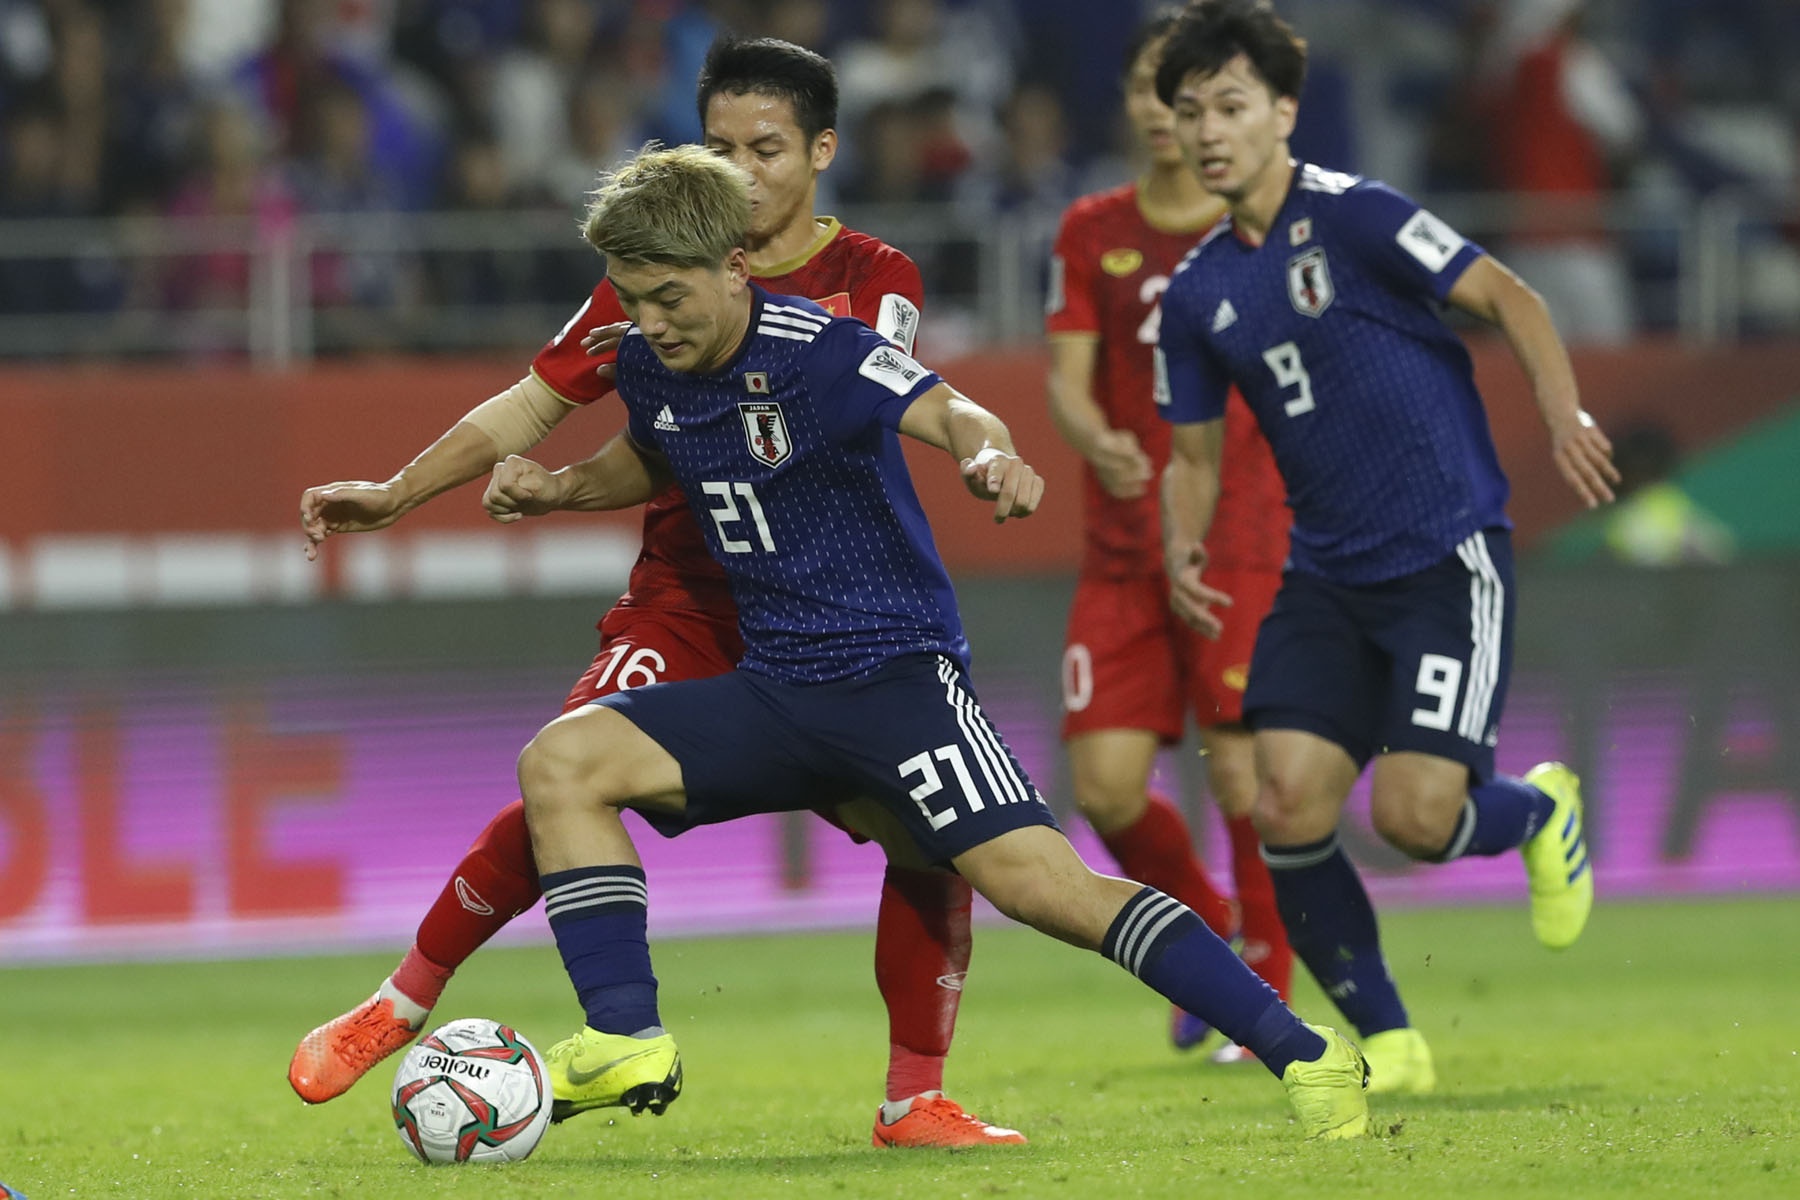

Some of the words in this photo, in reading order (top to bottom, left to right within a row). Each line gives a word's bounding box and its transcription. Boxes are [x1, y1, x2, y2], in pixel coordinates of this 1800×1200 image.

[1262, 341, 1315, 417] 9
[653, 420, 681, 432] adidas
[701, 482, 776, 553] 21
[595, 643, 666, 691] 16
[1411, 653, 1464, 731] 9
[897, 743, 986, 832] 21
